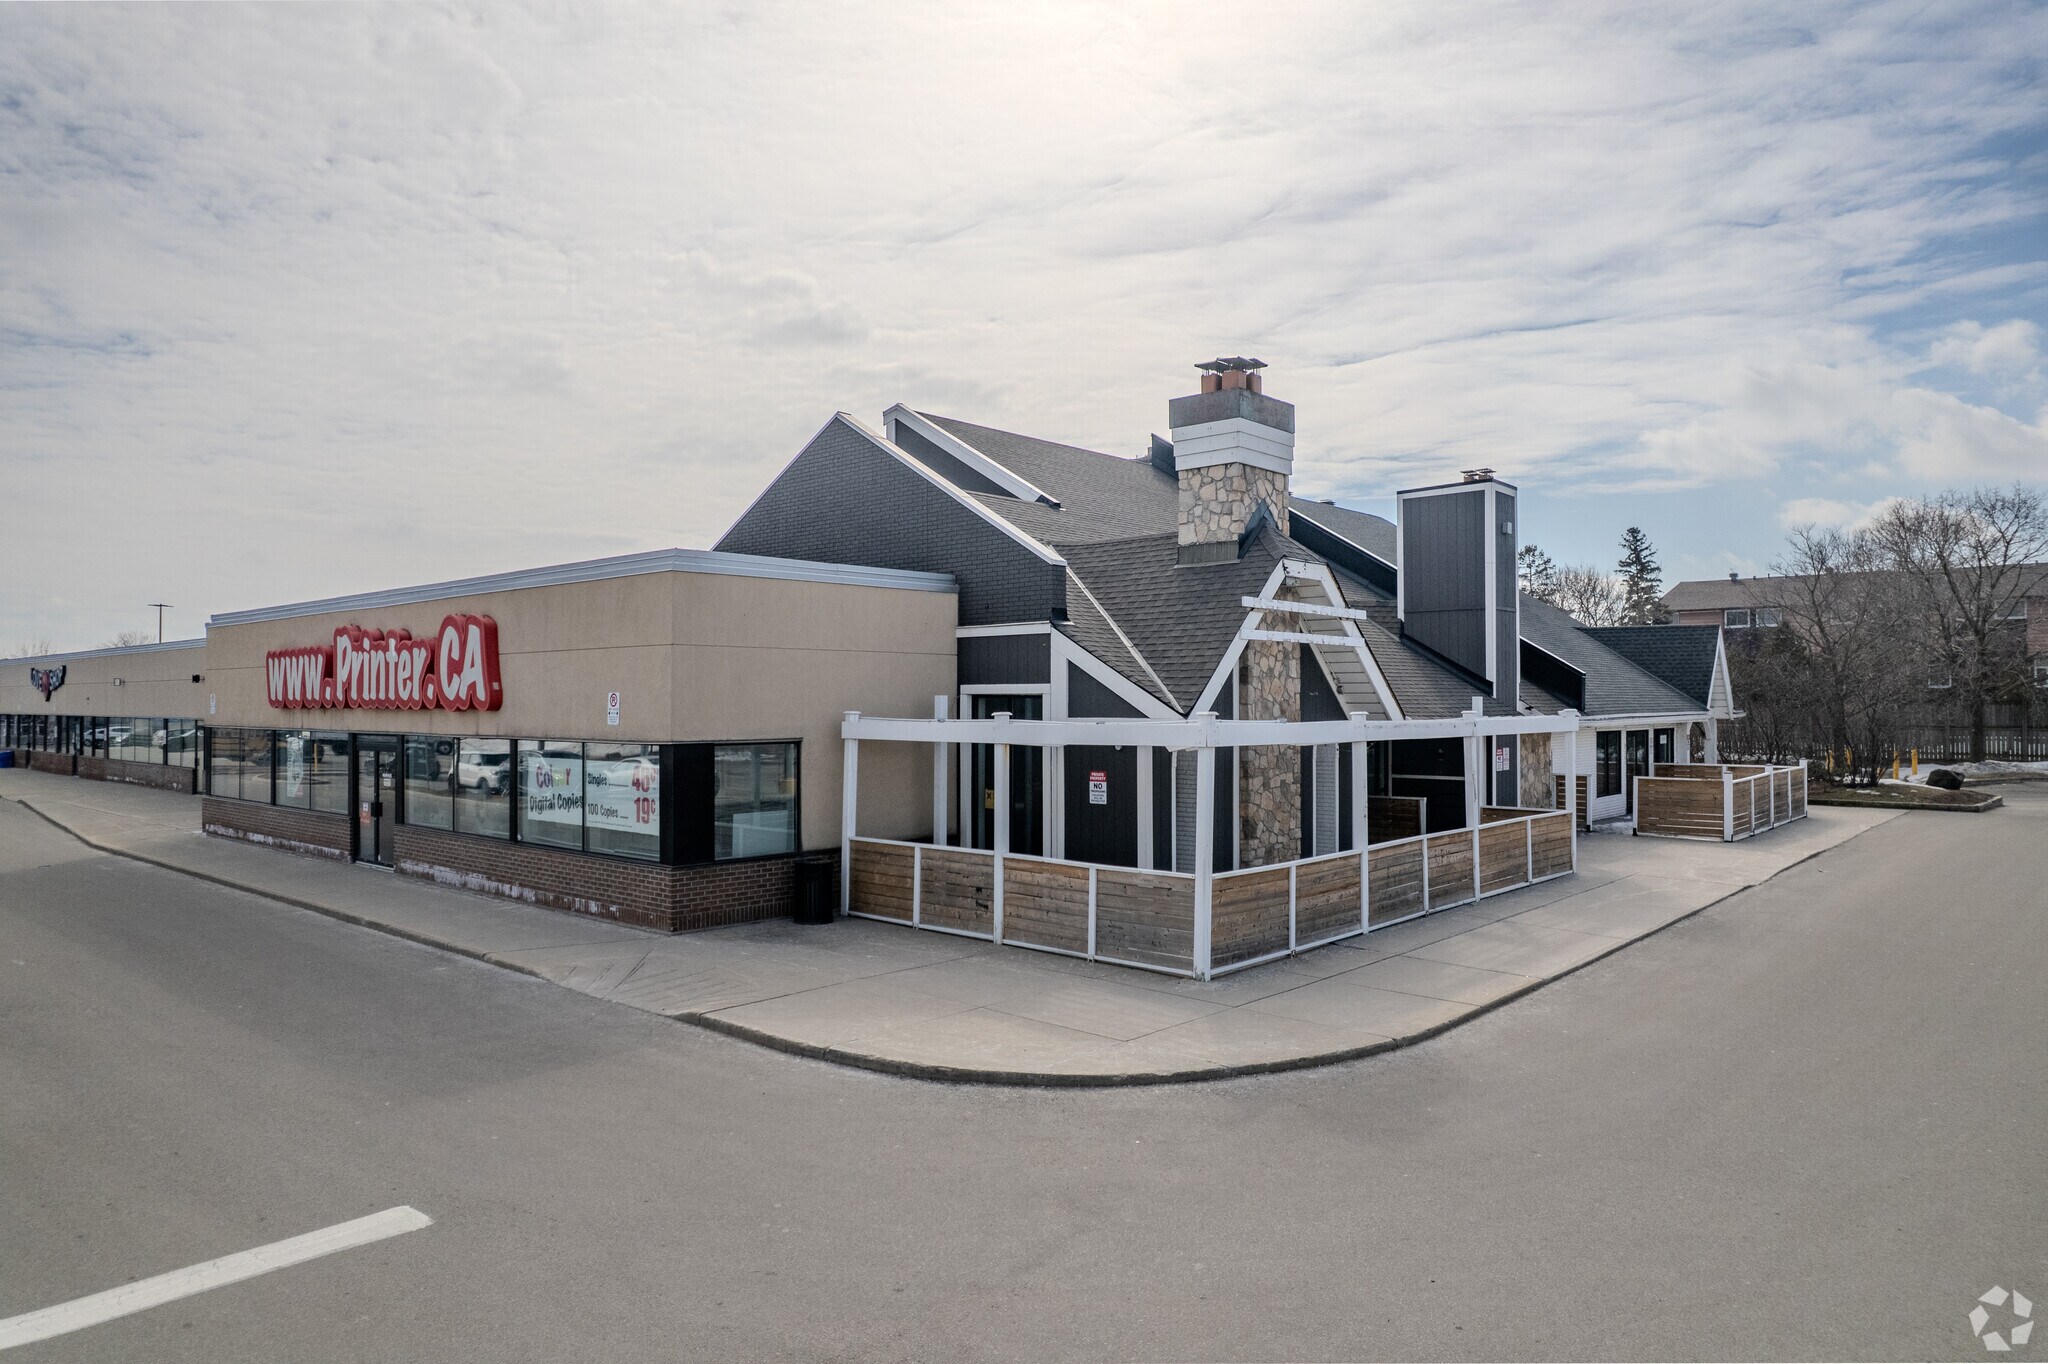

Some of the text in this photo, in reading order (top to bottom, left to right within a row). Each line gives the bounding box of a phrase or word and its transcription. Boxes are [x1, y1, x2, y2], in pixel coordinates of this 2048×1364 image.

[268, 624, 486, 701] www.Printer.CA
[587, 773, 608, 787] Singles
[529, 793, 583, 814] Digital Copies
[587, 803, 599, 815] 100
[600, 804, 619, 819] Copies
